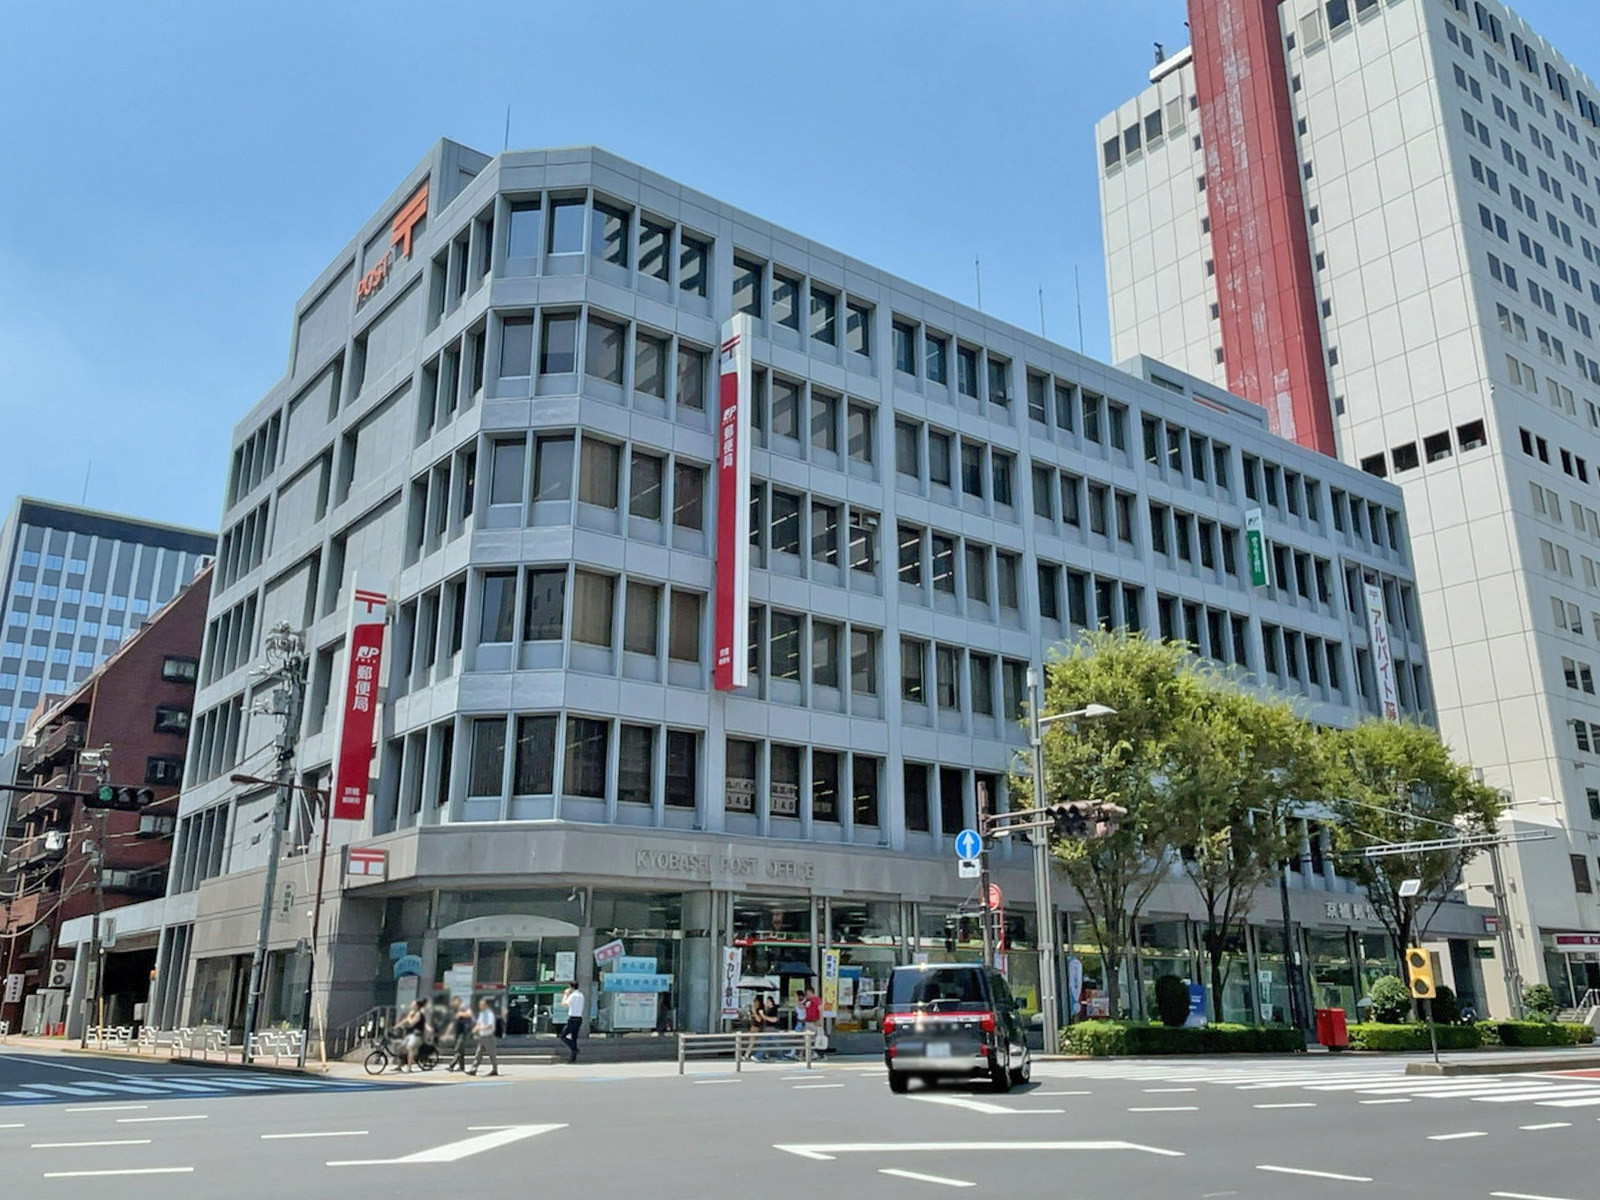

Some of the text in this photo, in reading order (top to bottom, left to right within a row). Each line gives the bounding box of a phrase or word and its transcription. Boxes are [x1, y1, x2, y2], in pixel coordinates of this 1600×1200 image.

[352, 664, 373, 712] 郵便局
[636, 850, 815, 881] KYOBASHI POST OFFICE
